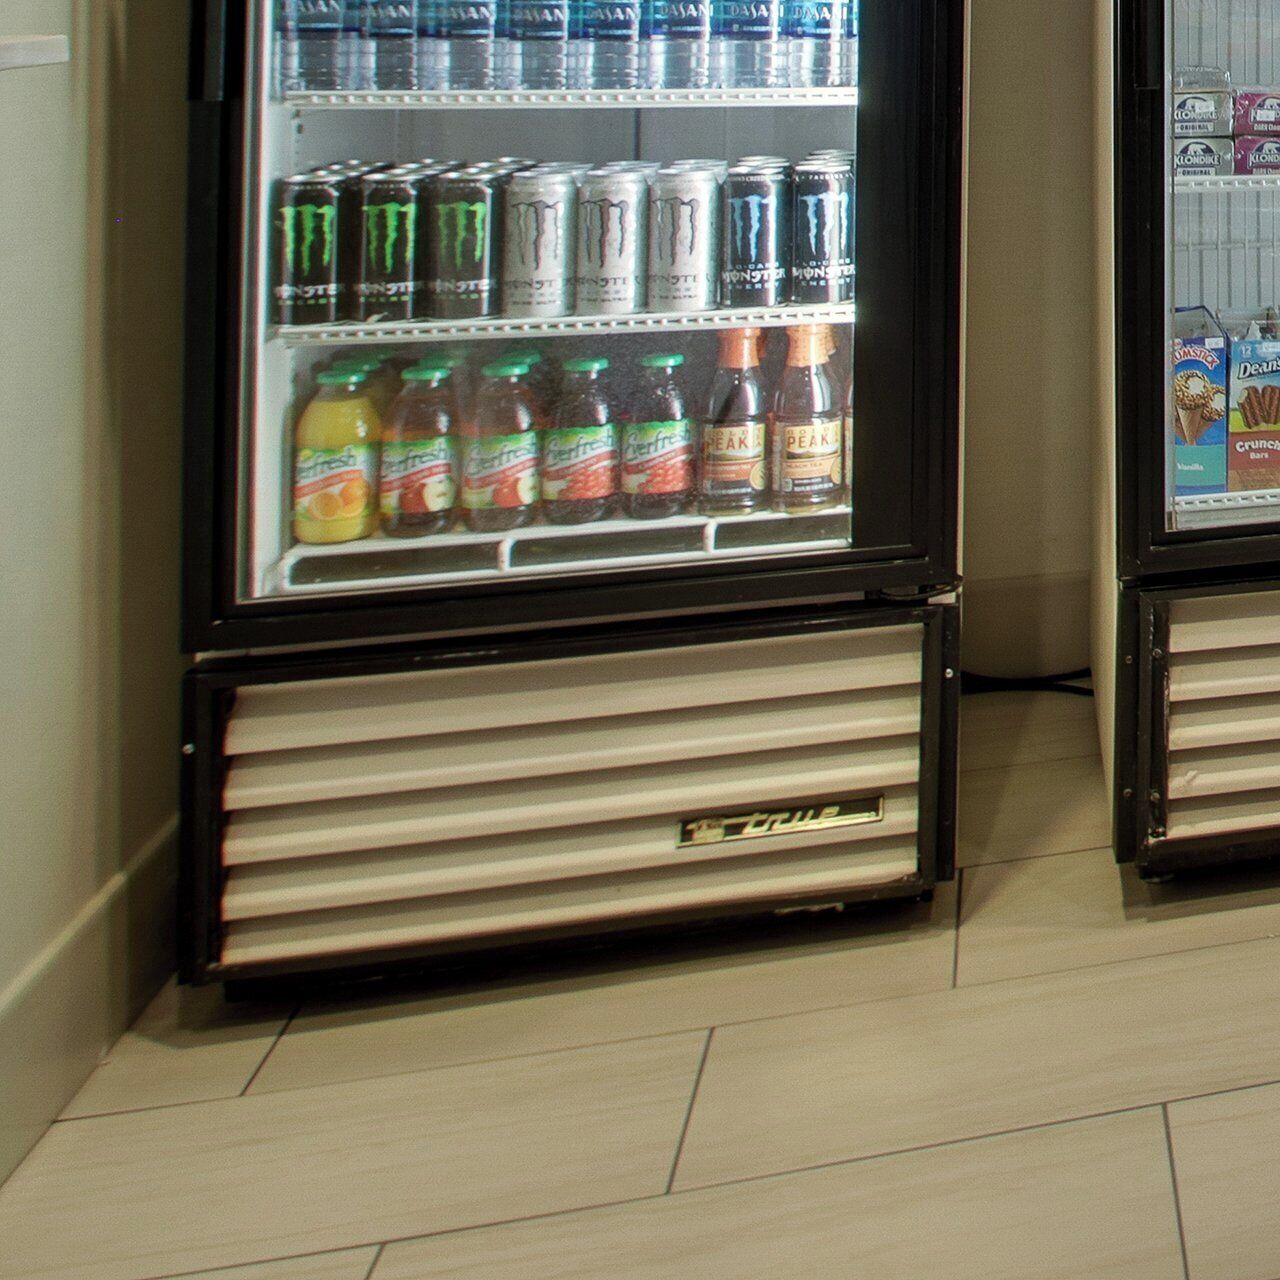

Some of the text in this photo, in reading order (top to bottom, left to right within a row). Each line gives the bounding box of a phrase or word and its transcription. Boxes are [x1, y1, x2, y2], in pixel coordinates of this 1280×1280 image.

[1174, 154, 1220, 165] KLONDIKE
[1241, 345, 1251, 355] 12
[1175, 348, 1219, 369] UMSTICK
[787, 435, 831, 450] PEAK
